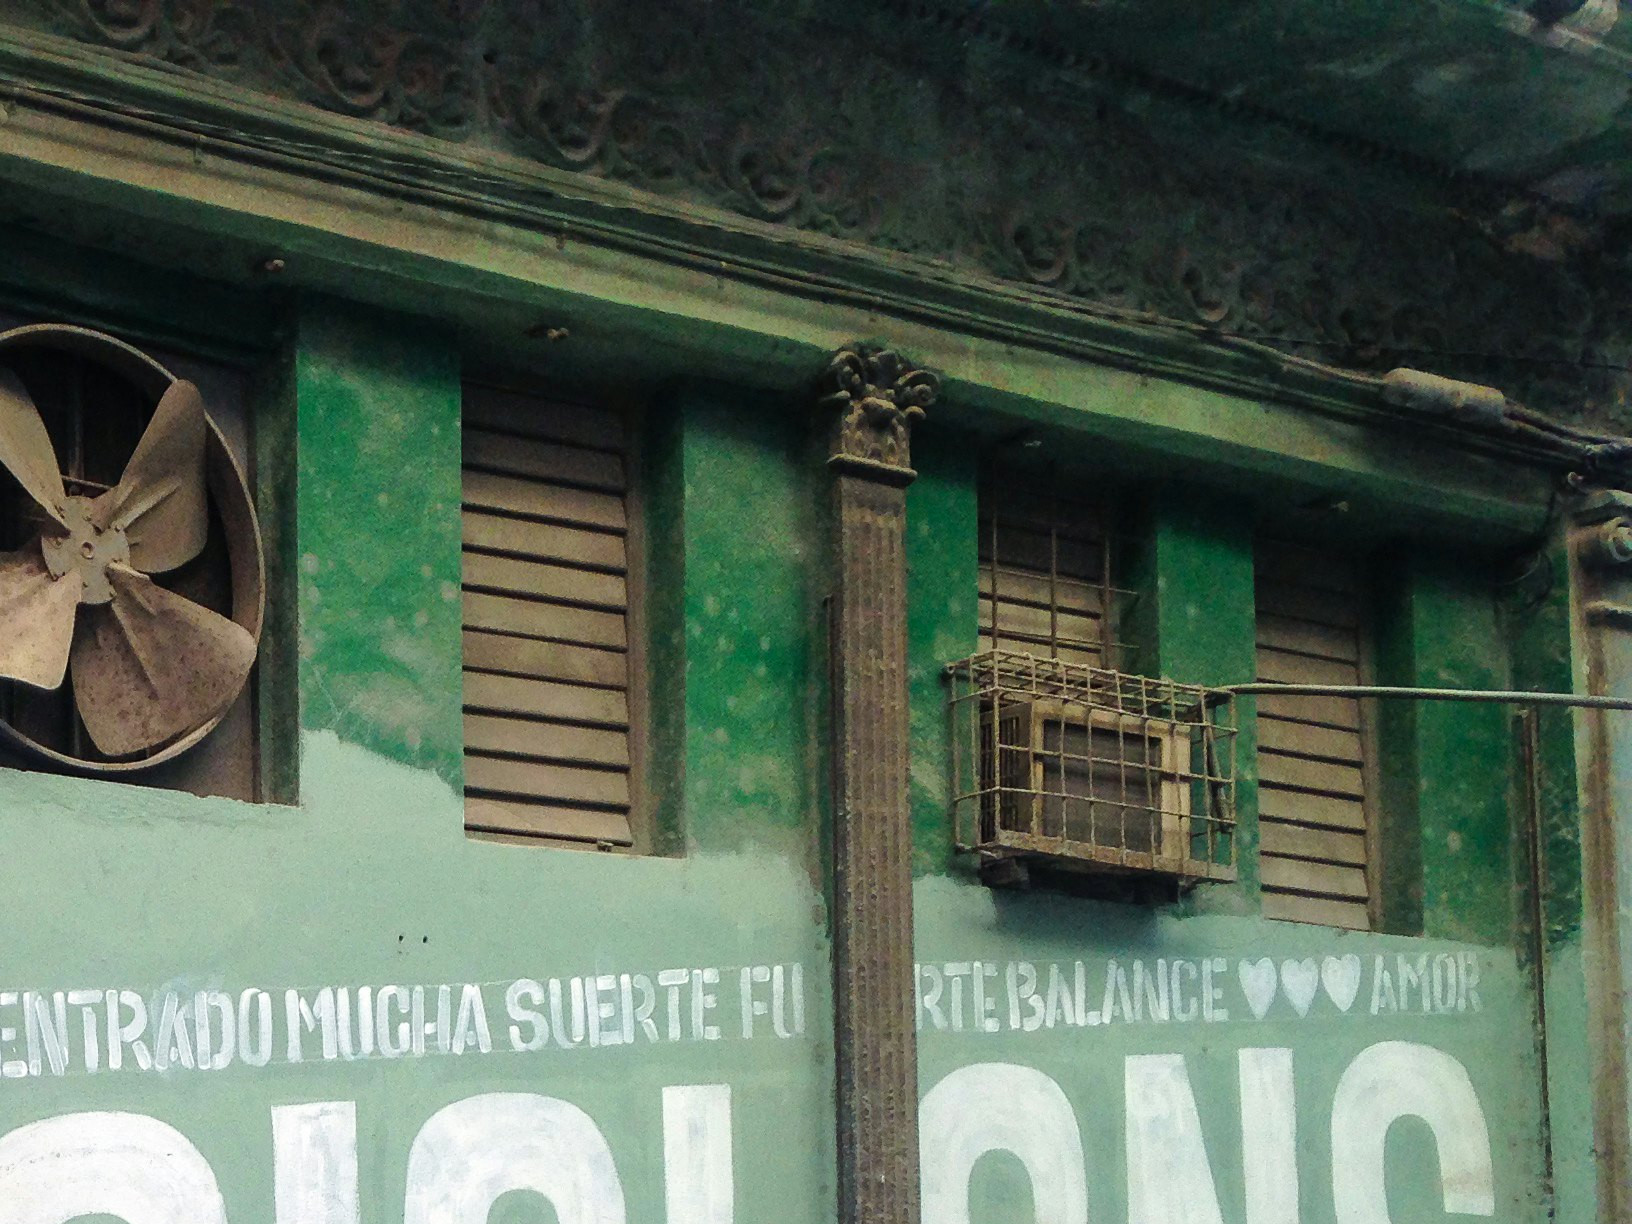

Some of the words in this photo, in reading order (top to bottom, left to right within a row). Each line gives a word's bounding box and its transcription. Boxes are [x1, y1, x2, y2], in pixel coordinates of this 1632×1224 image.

[285, 983, 492, 1061] MUCHA
[505, 968, 721, 1051] SUERTE
[1006, 957, 1229, 1032] BALANCE
[1370, 951, 1483, 1015] AMOR
